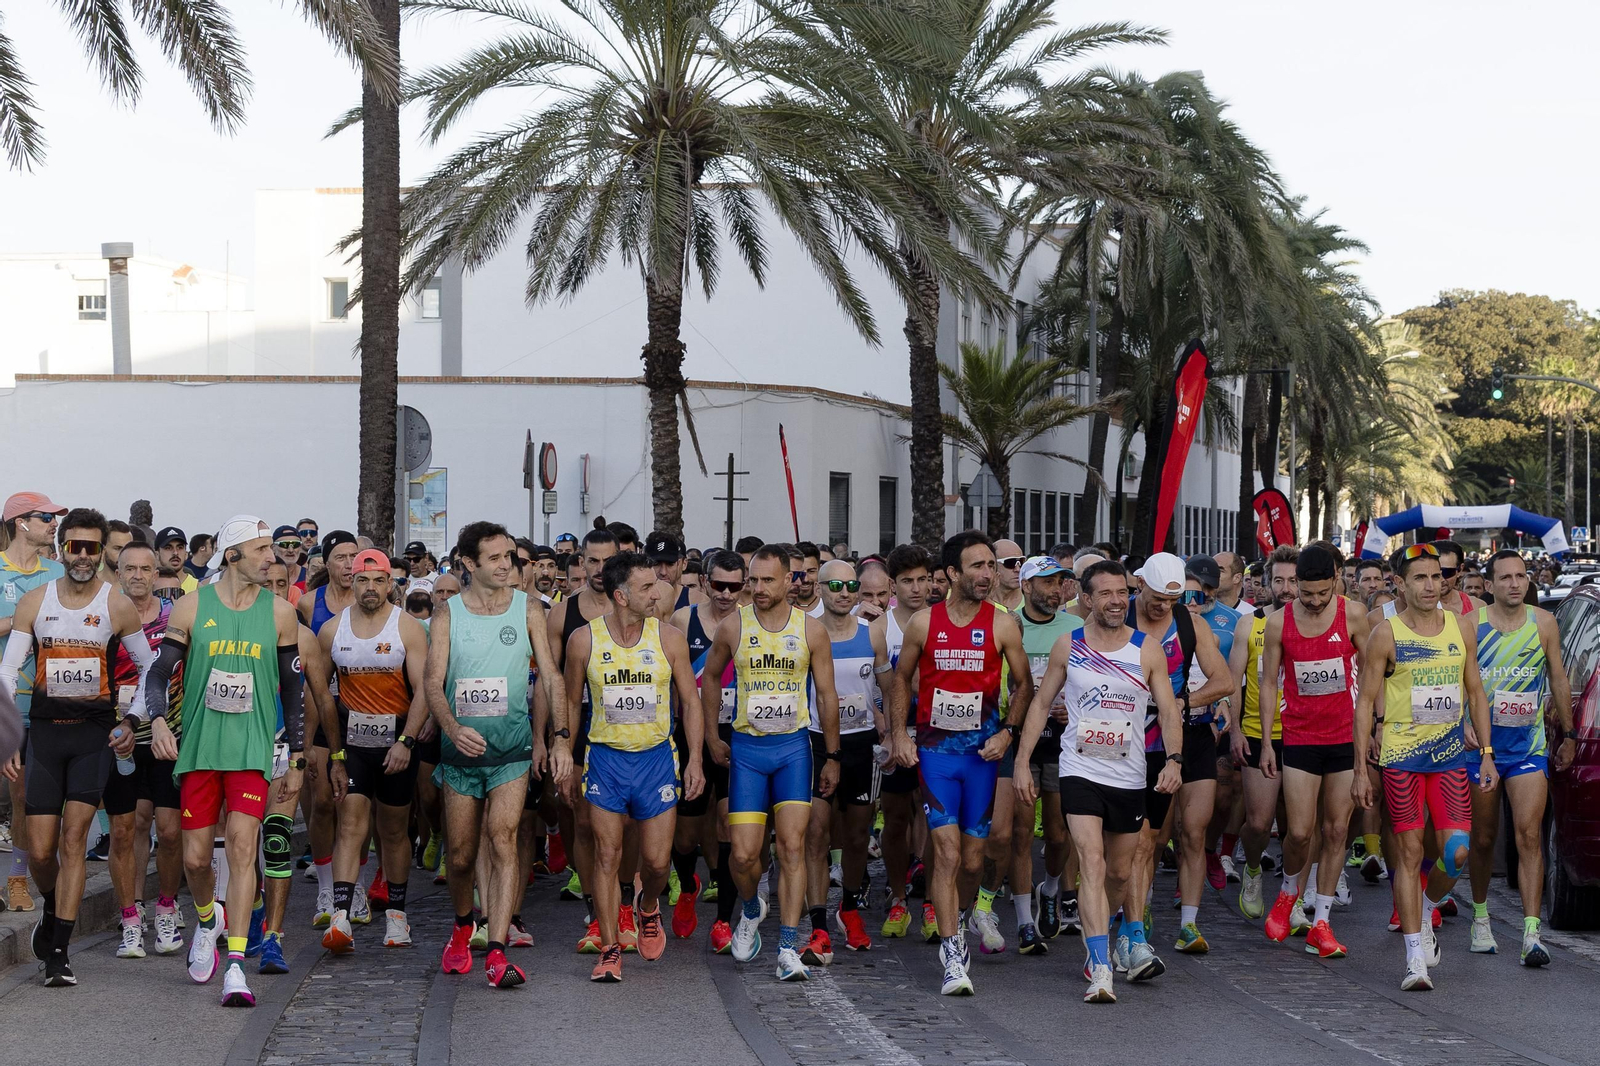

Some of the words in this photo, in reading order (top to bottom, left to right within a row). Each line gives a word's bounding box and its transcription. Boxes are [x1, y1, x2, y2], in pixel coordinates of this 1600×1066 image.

[55, 638, 101, 647] RUBYSAN
[934, 650, 949, 659] CLUB
[949, 650, 985, 660] ATLETISMO
[935, 659, 984, 672] TREBUJENA
[1411, 666, 1450, 677] CANILLAS
[1451, 665, 1460, 673] DE
[1493, 666, 1537, 677] HYGGE
[53, 670, 93, 684] 1645
[1301, 669, 1339, 684] 2394
[1412, 674, 1459, 687] ALBAIDA
[212, 682, 247, 700] 1972
[778, 679, 802, 692] CÁDI
[461, 689, 500, 704] 1632
[615, 696, 645, 711] 499
[1424, 696, 1452, 711] 470
[754, 704, 792, 720] 2244
[939, 702, 975, 718] 1536
[1499, 701, 1533, 716] 2563
[353, 723, 389, 737] 1782
[1084, 730, 1124, 746] 2581
